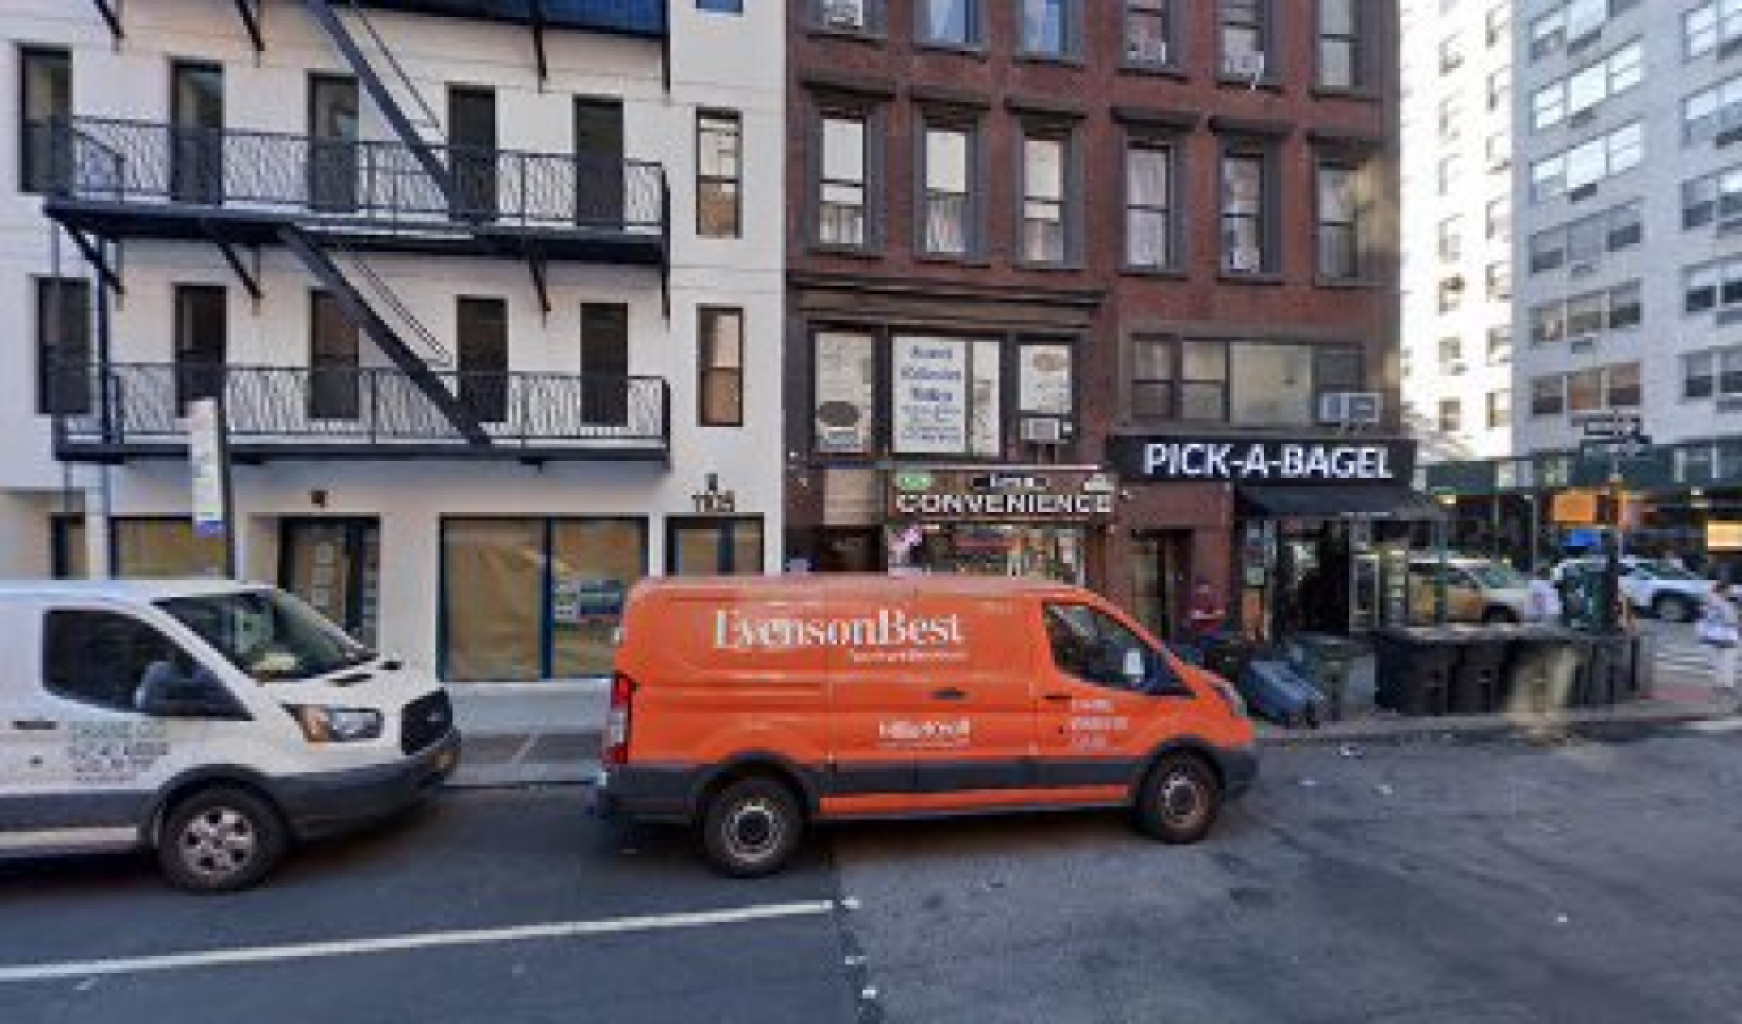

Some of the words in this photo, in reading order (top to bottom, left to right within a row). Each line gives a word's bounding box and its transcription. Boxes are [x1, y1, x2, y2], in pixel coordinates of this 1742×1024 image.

[1144, 443, 1393, 478] PICK-A-BAGEL
[896, 494, 1113, 513] CONVENIENCE
[713, 609, 965, 648] EvensonBest
